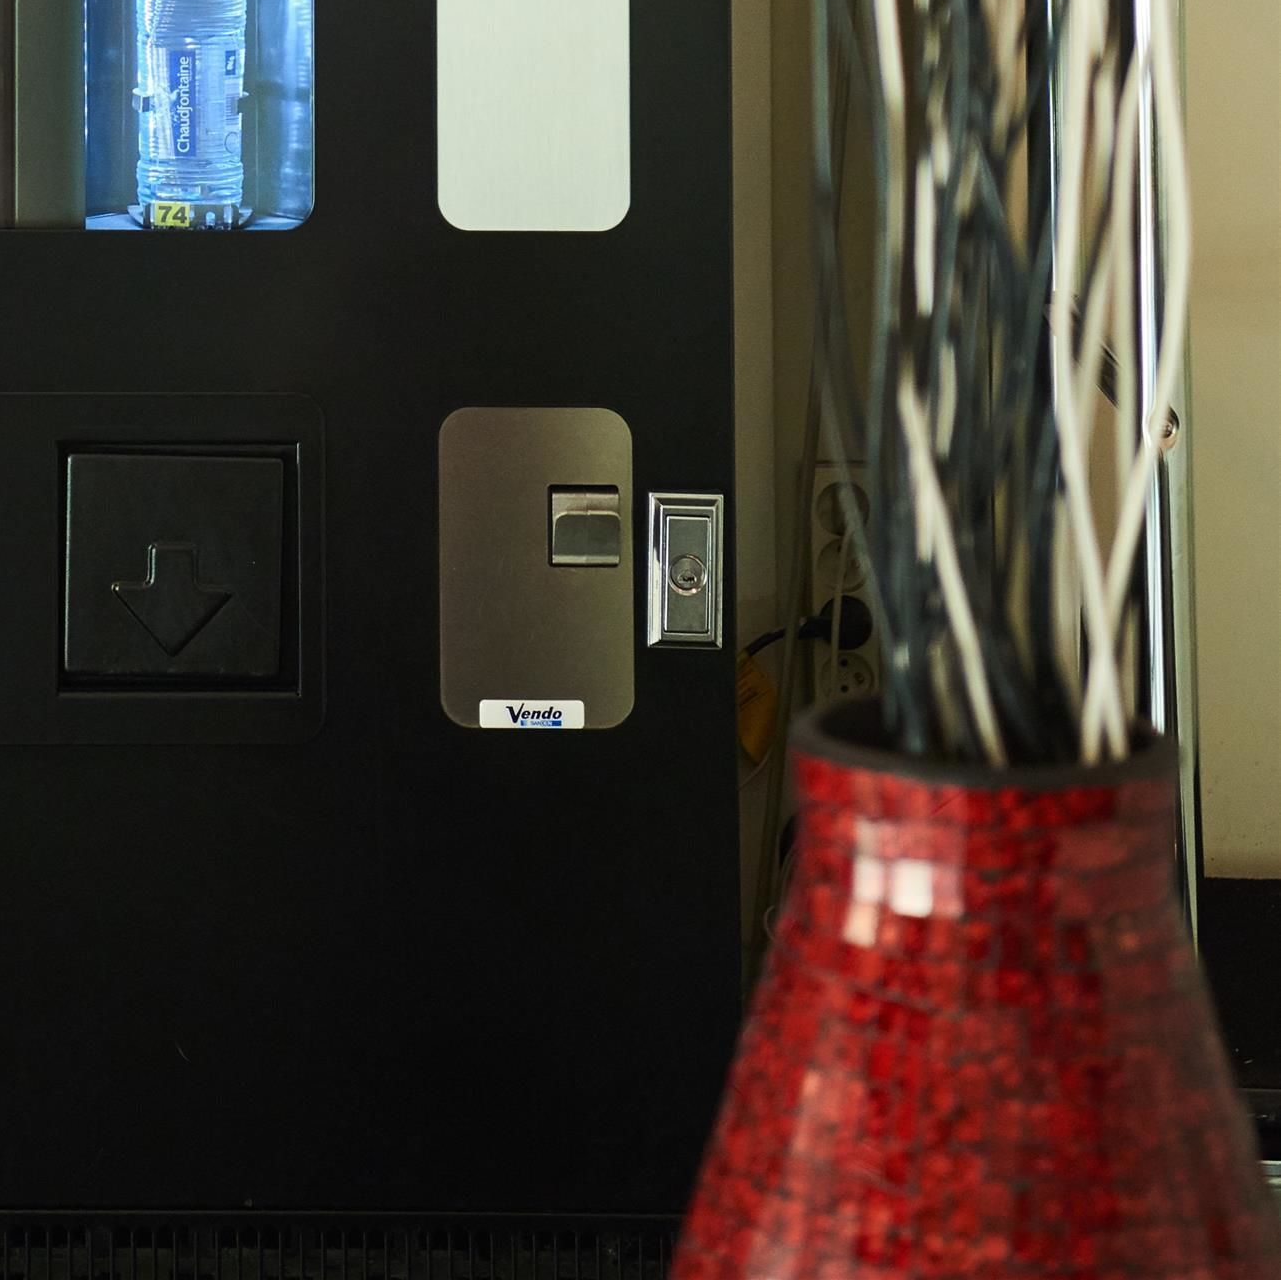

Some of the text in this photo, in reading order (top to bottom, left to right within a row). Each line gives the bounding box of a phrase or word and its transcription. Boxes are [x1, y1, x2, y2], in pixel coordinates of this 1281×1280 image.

[176, 56, 194, 153] Chaudfontaine
[157, 205, 188, 225] 74
[505, 702, 563, 724] Vendo
